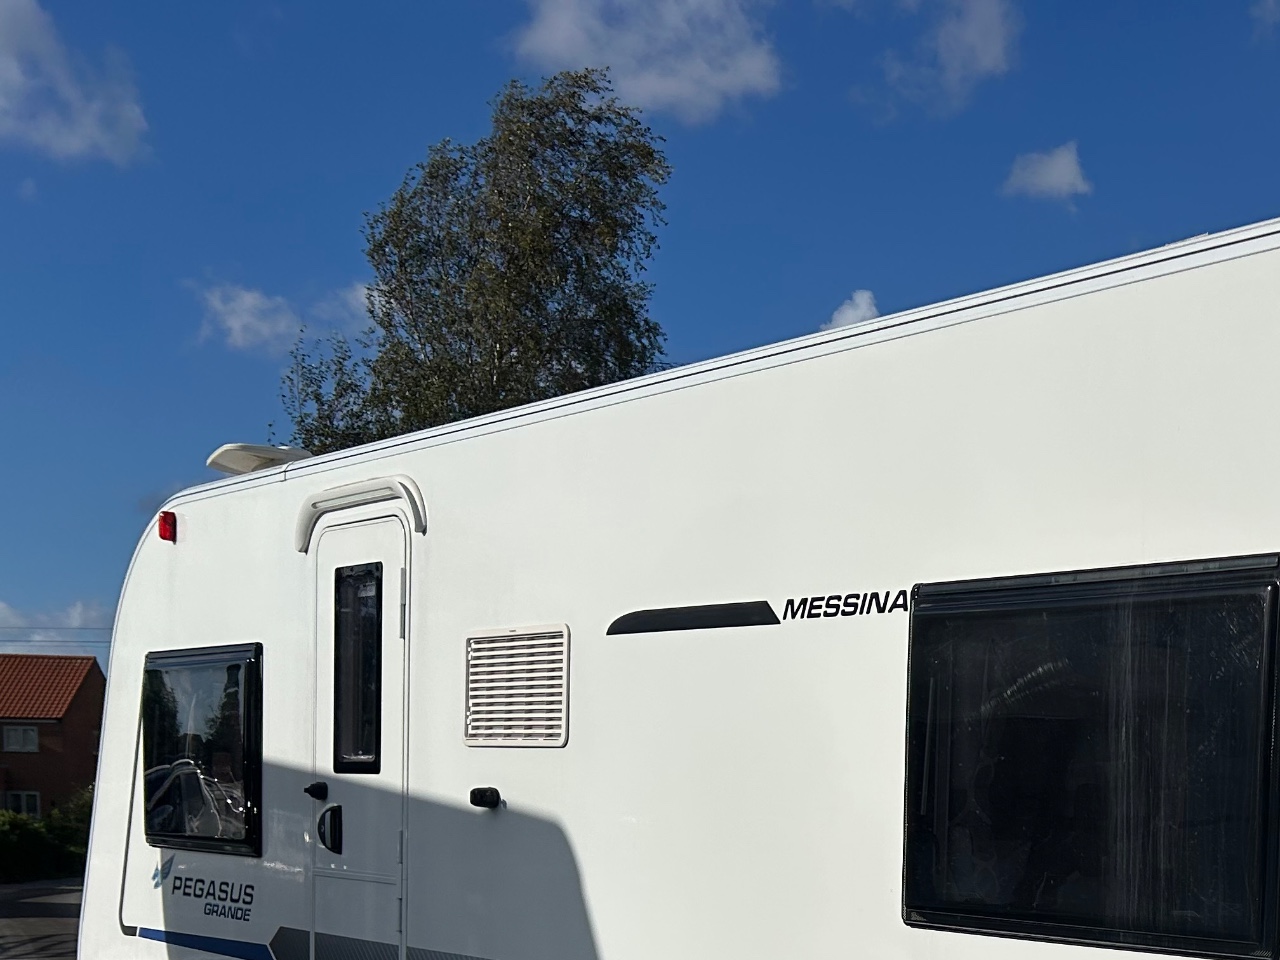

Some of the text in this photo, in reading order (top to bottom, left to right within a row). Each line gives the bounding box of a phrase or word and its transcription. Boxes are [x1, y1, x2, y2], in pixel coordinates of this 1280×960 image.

[782, 589, 909, 620] MESSINA
[171, 875, 255, 905] PEGASUS
[203, 902, 252, 922] GRANDE
